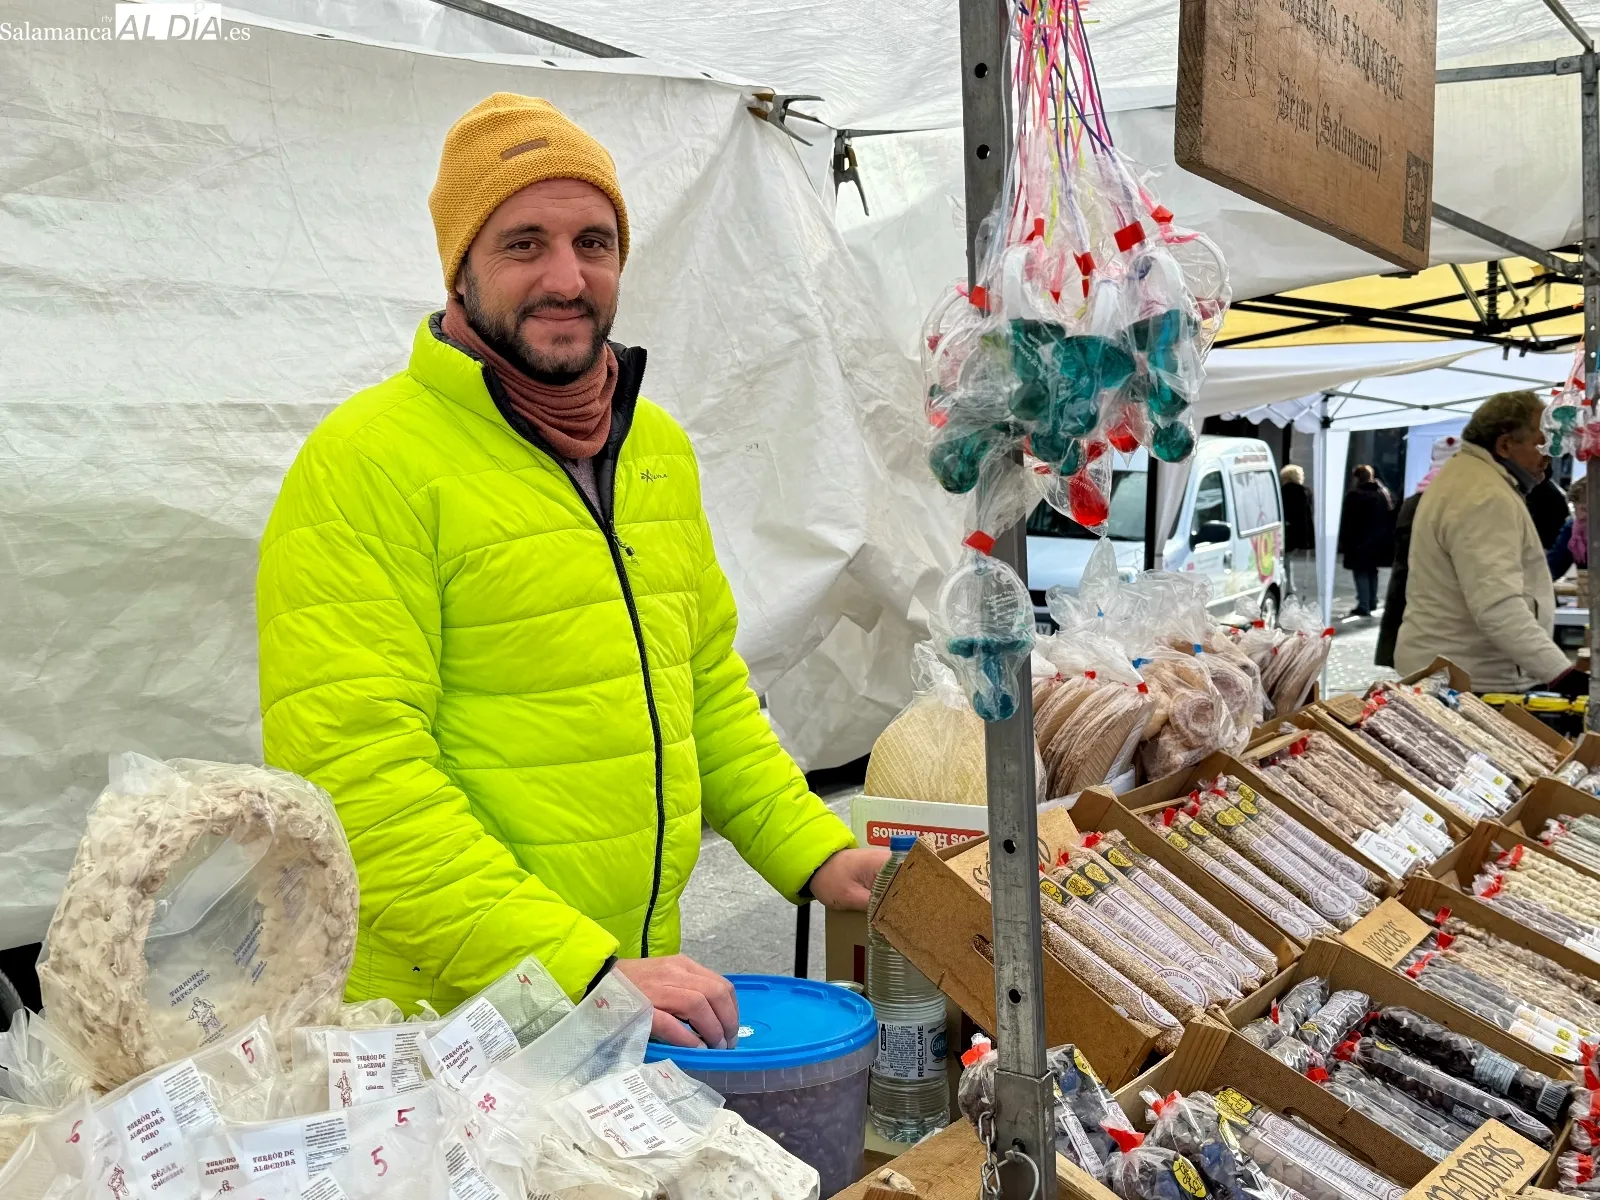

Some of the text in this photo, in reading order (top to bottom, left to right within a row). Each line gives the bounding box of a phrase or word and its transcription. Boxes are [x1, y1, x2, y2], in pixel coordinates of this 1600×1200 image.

[241, 1036, 255, 1065] 5
[394, 1106, 416, 1128] 5
[65, 1119, 83, 1144] 6
[140, 1129, 160, 1144] DURO
[252, 1148, 295, 1164] TURRÓN DE
[253, 1158, 296, 1173] ALMENDRA
[370, 1145, 388, 1177] 5
